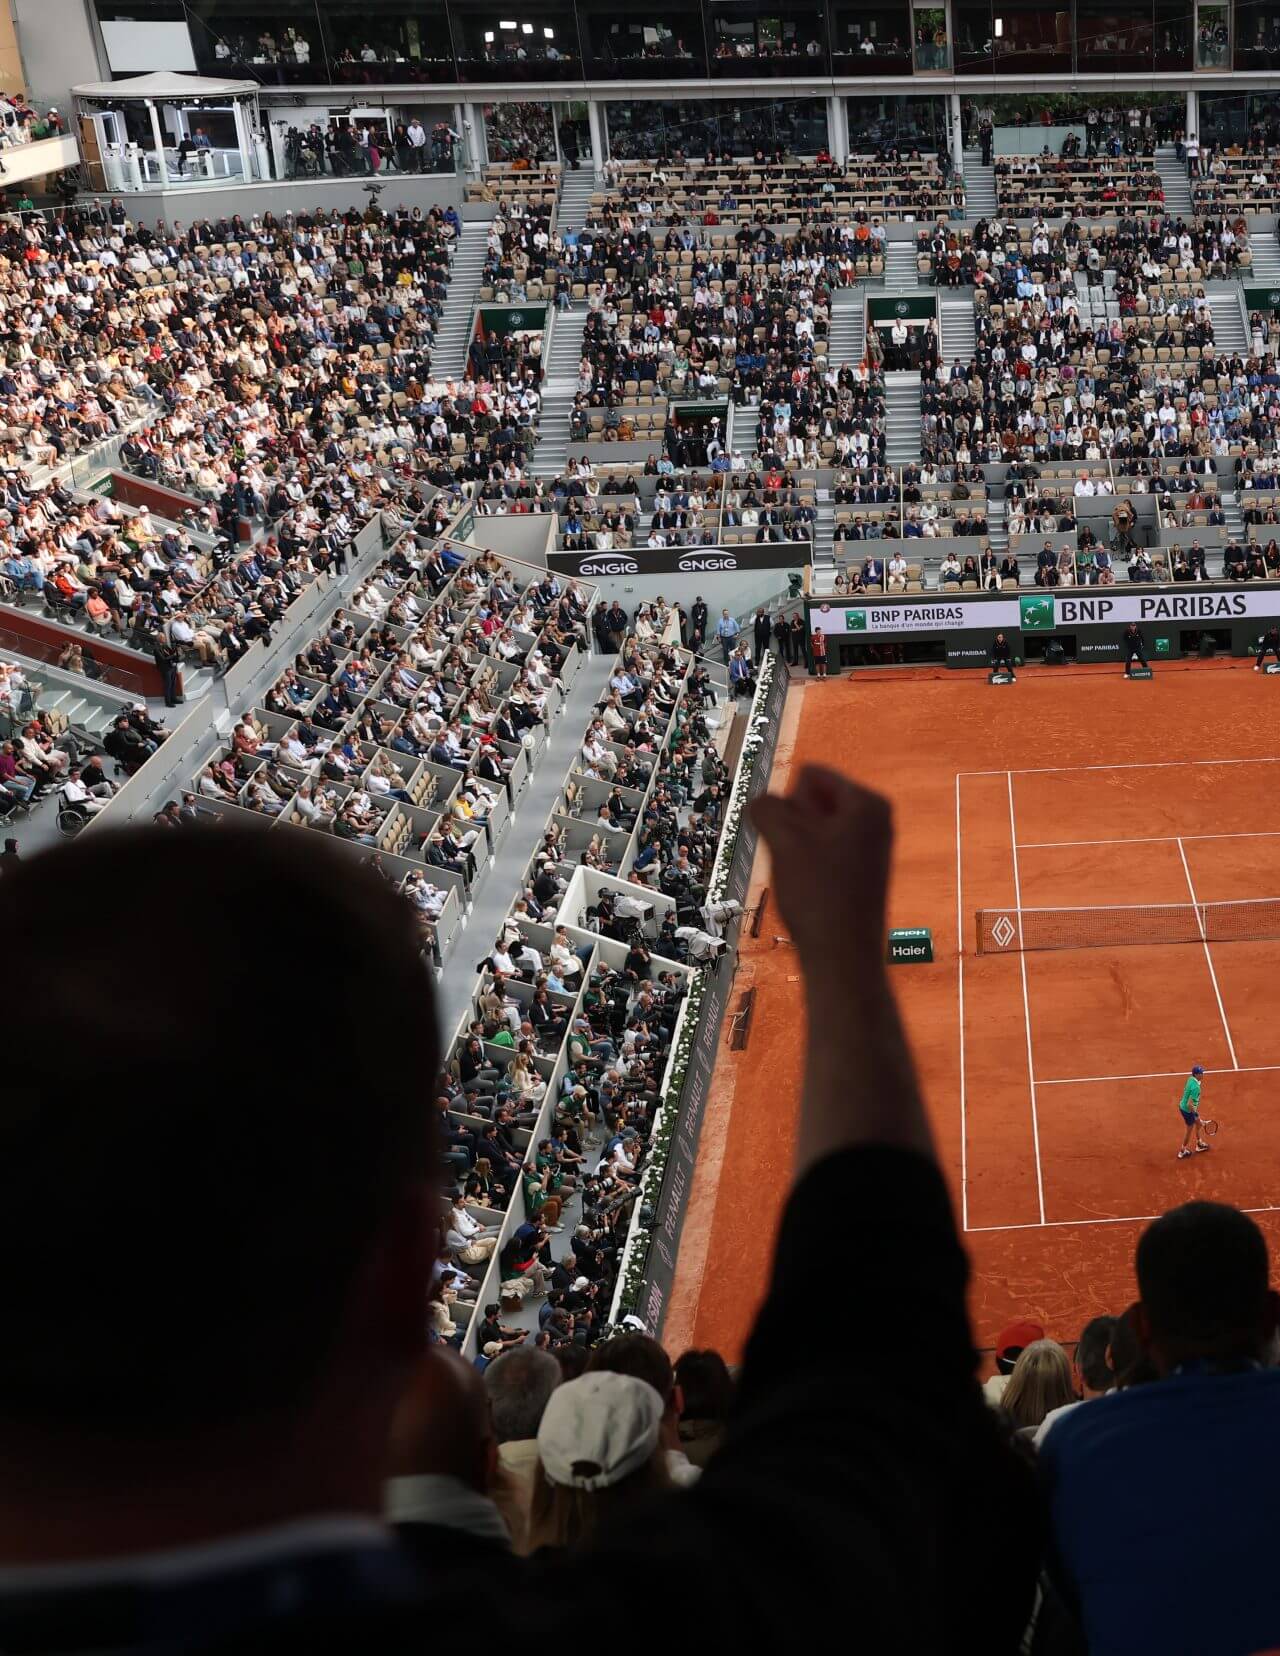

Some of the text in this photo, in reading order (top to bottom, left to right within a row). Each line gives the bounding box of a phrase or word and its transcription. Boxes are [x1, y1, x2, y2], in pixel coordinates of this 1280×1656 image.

[871, 607, 964, 623] BNP PARIBAS
[1061, 594, 1247, 622] BNP PARIBAS
[892, 945, 926, 957] Haier
[664, 1161, 687, 1240] RENAULT
